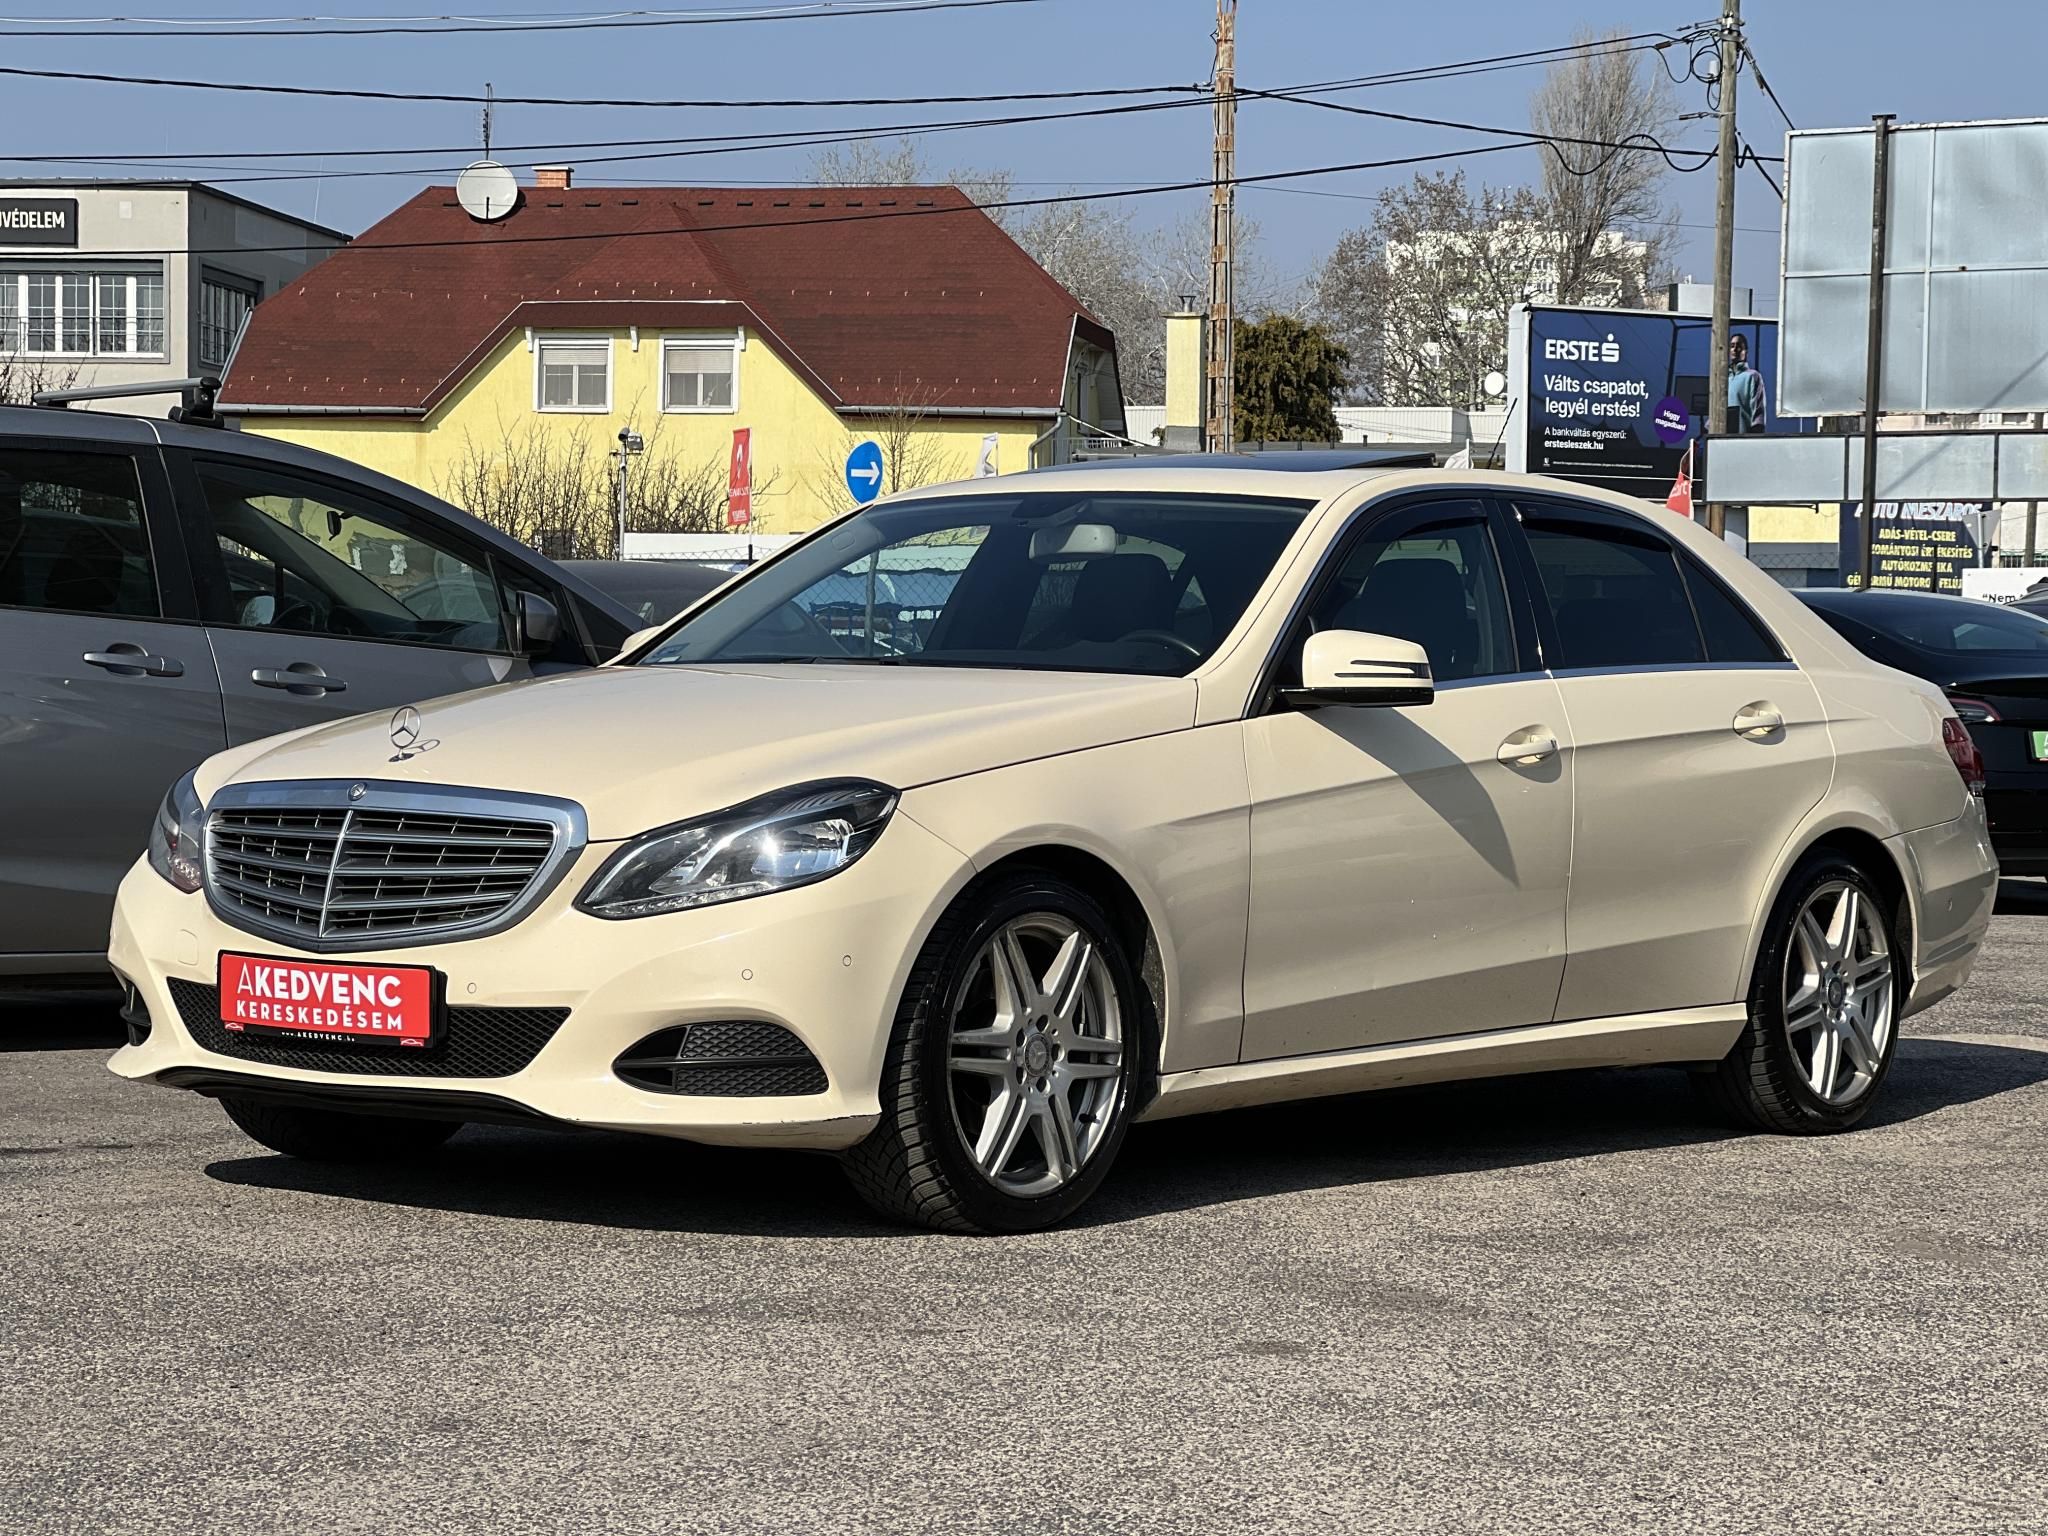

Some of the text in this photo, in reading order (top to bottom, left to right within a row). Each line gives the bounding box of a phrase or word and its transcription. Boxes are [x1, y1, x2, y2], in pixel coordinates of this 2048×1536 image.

[0, 208, 65, 229] VÉDELEM
[1545, 339, 1600, 362] ERSTE
[1543, 374, 1649, 399] Válts csapatot,
[1545, 397, 1640, 418] legyél erstés!
[1663, 410, 1680, 422] Higgy
[1544, 427, 1627, 440] A bankváltás egyszerű:
[1655, 418, 1686, 431] magadban!
[1544, 440, 1604, 450] erstesleszek.hu
[1879, 528, 1956, 542] ADÁS-VÉTEL-CSERE
[1921, 543, 1974, 559] ÉRÉKESÍTÉS
[236, 961, 403, 1008] AKEDVENC
[236, 999, 403, 1031] KERESKEDÉSEM
